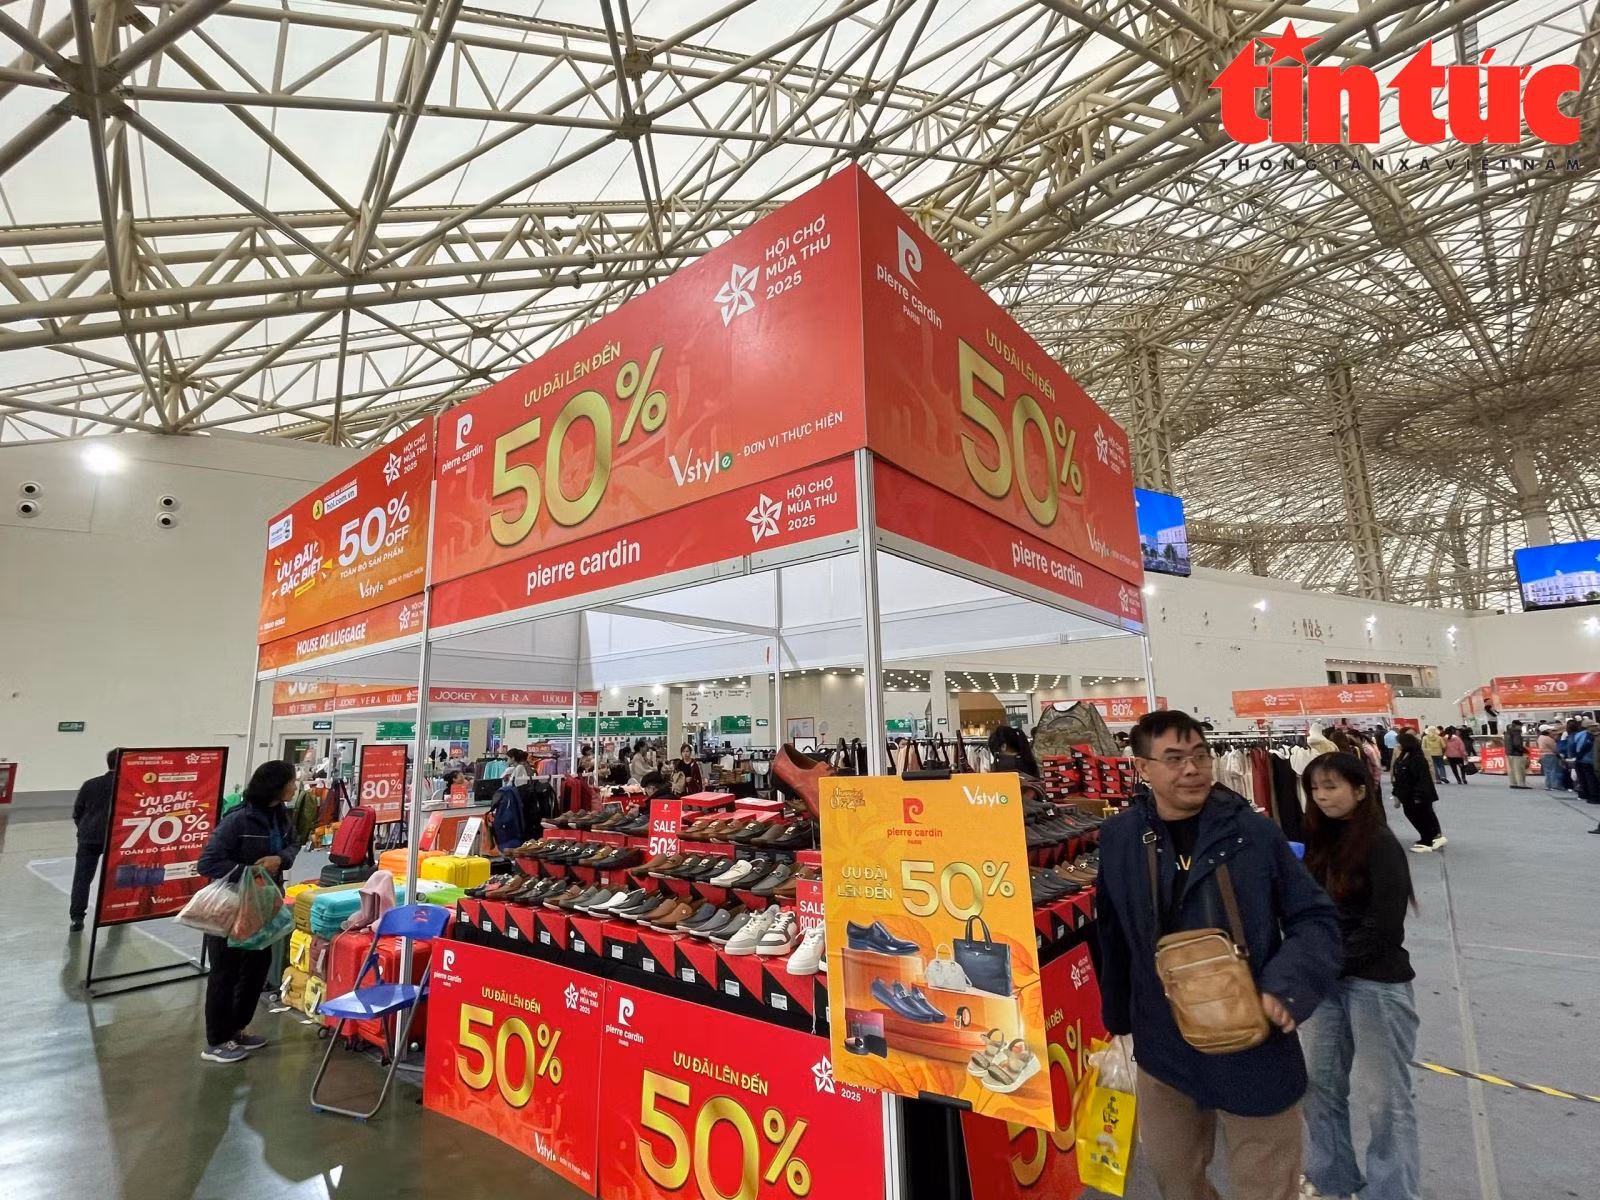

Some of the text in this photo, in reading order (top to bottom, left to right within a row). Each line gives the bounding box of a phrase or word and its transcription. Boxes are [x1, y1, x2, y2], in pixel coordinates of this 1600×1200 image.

[765, 213, 826, 261] HỘI CHỢ
[765, 233, 831, 281] MÙA THU
[766, 269, 802, 300] 2025
[876, 263, 943, 330] pierre cardin
[985, 327, 1002, 355] ƯU
[1003, 343, 1021, 372] ĐÃI
[1021, 360, 1038, 386] LÊN
[524, 340, 621, 408] ƯU ĐÃI LÊN ĐẾN
[957, 336, 1083, 528] 50%
[490, 344, 670, 547] 50%
[668, 411, 844, 487] Vstyle ĐƠN VỊ THỰC HIỆN
[441, 444, 484, 476] pierre cardin
[786, 475, 834, 500] HỘI CHỢ
[787, 492, 838, 516] MÙA THU
[338, 491, 411, 567] 50%
[787, 514, 816, 532] 2025
[385, 524, 410, 548] OFF
[276, 560, 293, 583] ƯU
[526, 539, 641, 596] pierre cardin
[1011, 538, 1049, 575] pierre
[1050, 555, 1084, 590] cardin
[296, 623, 367, 657] HOUSE OF LUGGAGE
[359, 695, 382, 706] VERA
[435, 691, 478, 701] JOCKEY
[488, 692, 531, 703] VERA
[690, 703, 699, 714] 2
[1111, 703, 1134, 717] 80%
[139, 790, 187, 808] ƯU ĐÃI
[361, 779, 402, 800] 80%
[961, 784, 1009, 809] Vstyle
[145, 799, 199, 816] ĐẶC BIỆT
[119, 813, 210, 849] 70%
[181, 831, 209, 843] OFF
[653, 819, 676, 834] SALE
[887, 827, 943, 840] pierre cardin
[119, 848, 144, 856] TOÀN
[650, 837, 677, 856] 50%
[841, 866, 862, 879] ƯU
[900, 859, 1015, 921] 50%
[799, 900, 825, 914] SALE
[433, 971, 462, 984] pierre cardin
[481, 986, 541, 1015] ƯU ĐÃI LÊN ĐẾN
[579, 986, 589, 996] HỘI
[579, 1005, 591, 1015] 2025
[589, 999, 599, 1009] THU
[605, 1023, 644, 1044] pierre cardin
[456, 1002, 563, 1108] 50%
[672, 1050, 768, 1097] ƯU ĐÃI LÊN ĐẾN
[841, 1088, 862, 1102] 2025
[639, 1066, 812, 1200] 50%
